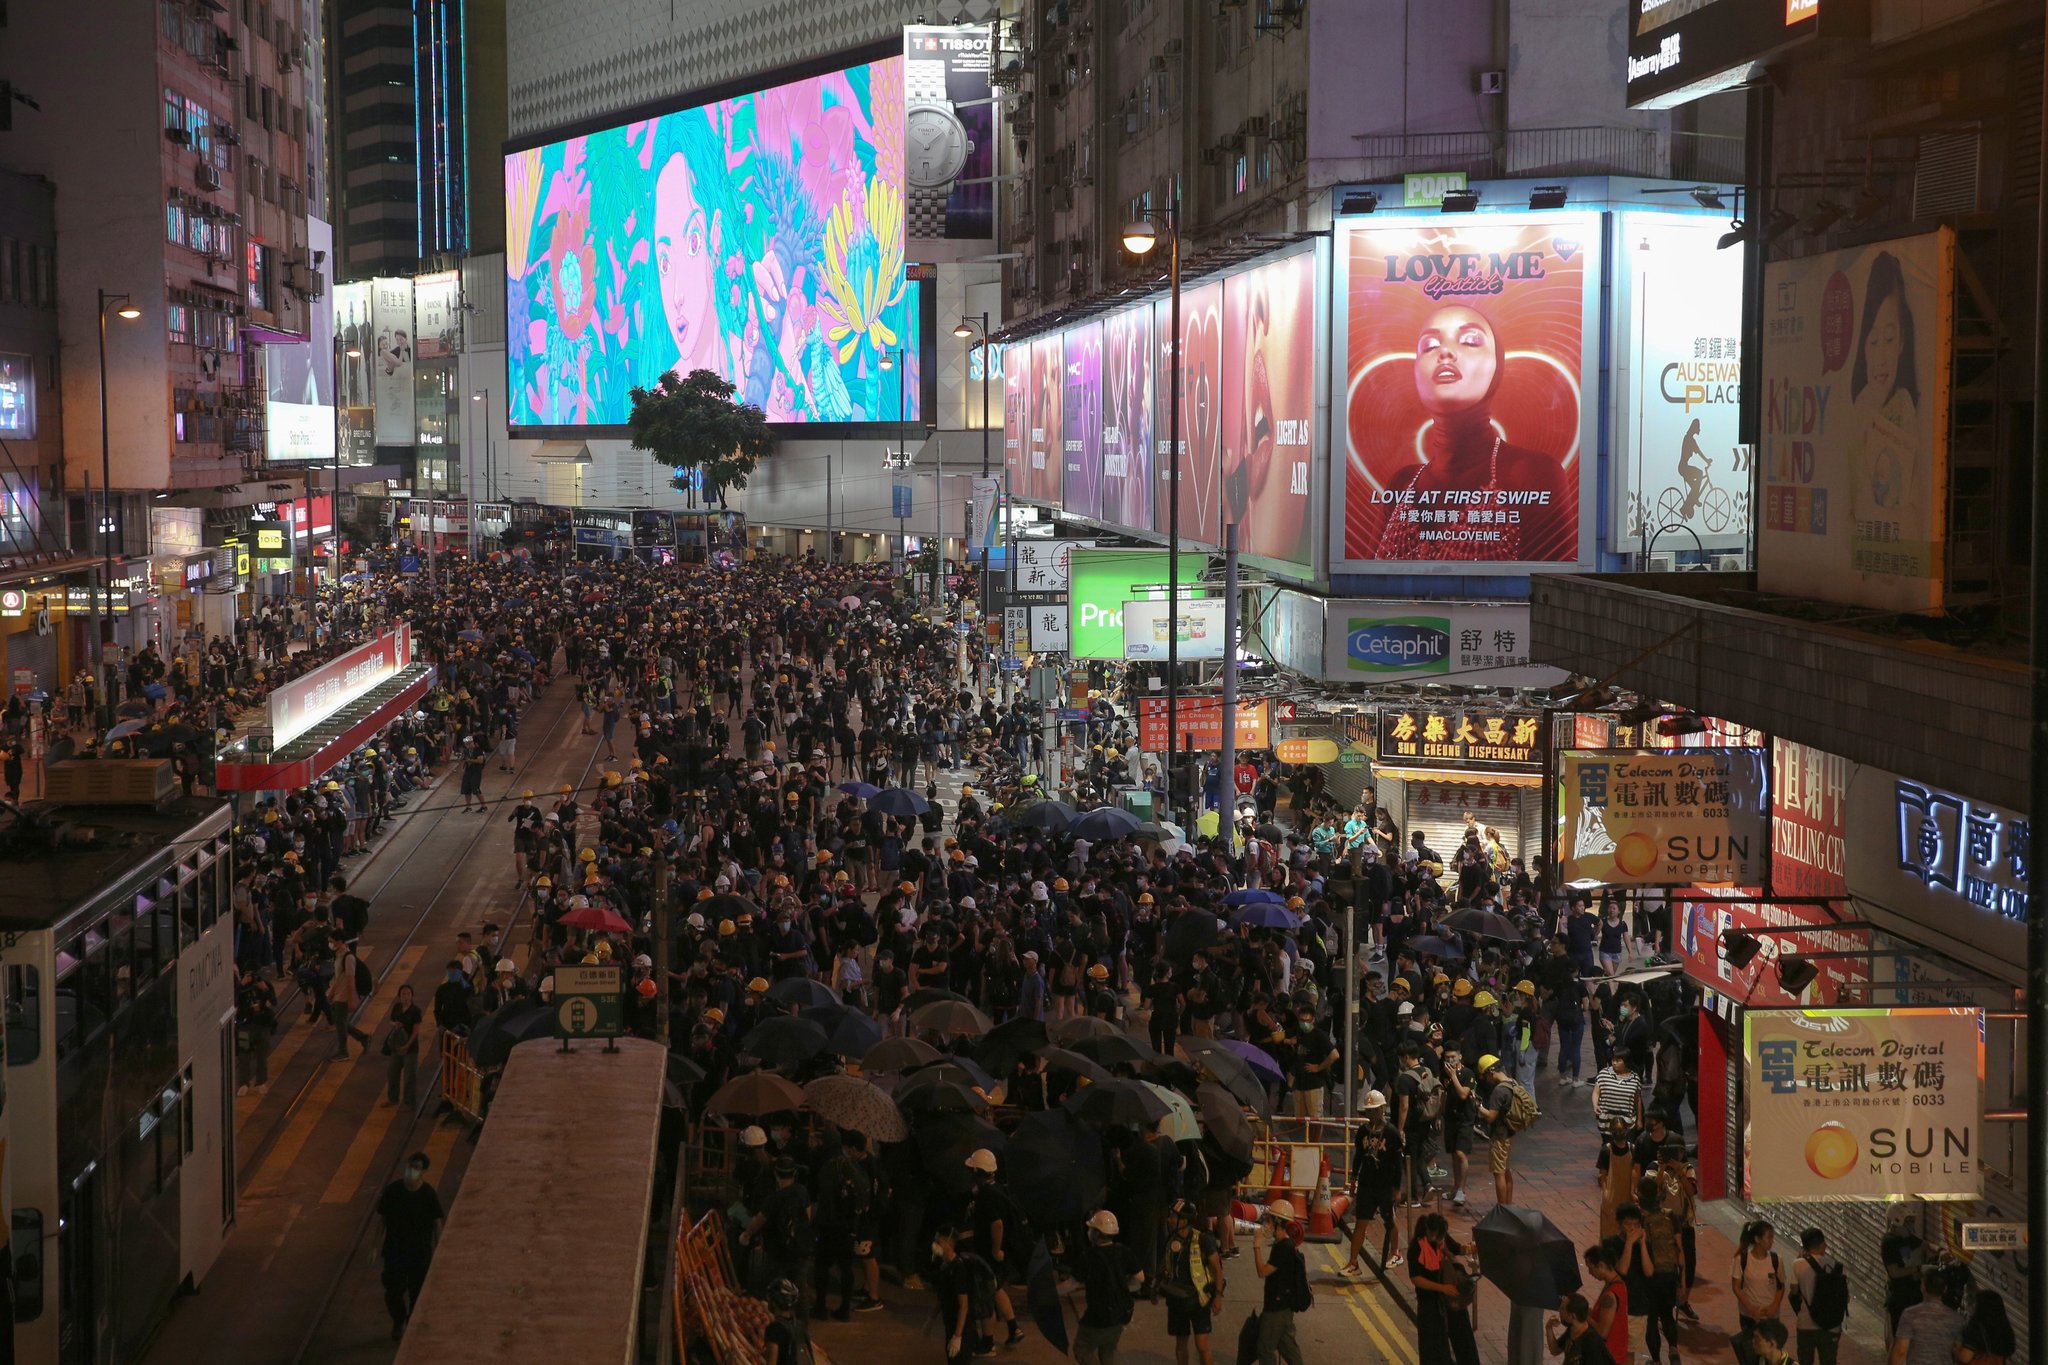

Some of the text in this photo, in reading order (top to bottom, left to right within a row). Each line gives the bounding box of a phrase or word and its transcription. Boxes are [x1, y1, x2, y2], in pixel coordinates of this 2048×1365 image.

[940, 39, 991, 50] TISSOT
[1407, 176, 1463, 199] POAD
[1384, 252, 1545, 281] LOVE ME
[1423, 273, 1503, 300] lipstick
[1694, 337, 1736, 359] 銅鑼灣
[1276, 419, 1309, 445] LIGHT AS
[1767, 437, 1815, 484] LAND
[388, 479, 398, 488] TSL
[1290, 461, 1309, 495] AIR
[1370, 491, 1551, 505] LOVE AT FIRST SWIPE
[1467, 510, 1520, 524] 酷愛自己
[1419, 530, 1501, 541] #MACLOVEME
[1355, 633, 1442, 660] Cetaphil
[1397, 742, 1530, 760] SUN CHEUNG DISPENSARY
[1614, 763, 1730, 780] Telecom Digital
[1614, 780, 1730, 807] 電訊數碼
[1703, 808, 1729, 818] 6033
[1667, 835, 1748, 861] SUN
[1781, 818, 1826, 870] SELLING
[1667, 864, 1748, 875] MOBILE
[1802, 1039, 1945, 1060] Telecom Digital
[1803, 1060, 1945, 1093] 電訊數碼
[1912, 1094, 1945, 1106] 6033
[1869, 1127, 1970, 1158] SUN
[1870, 1162, 1970, 1175] MOBILE
